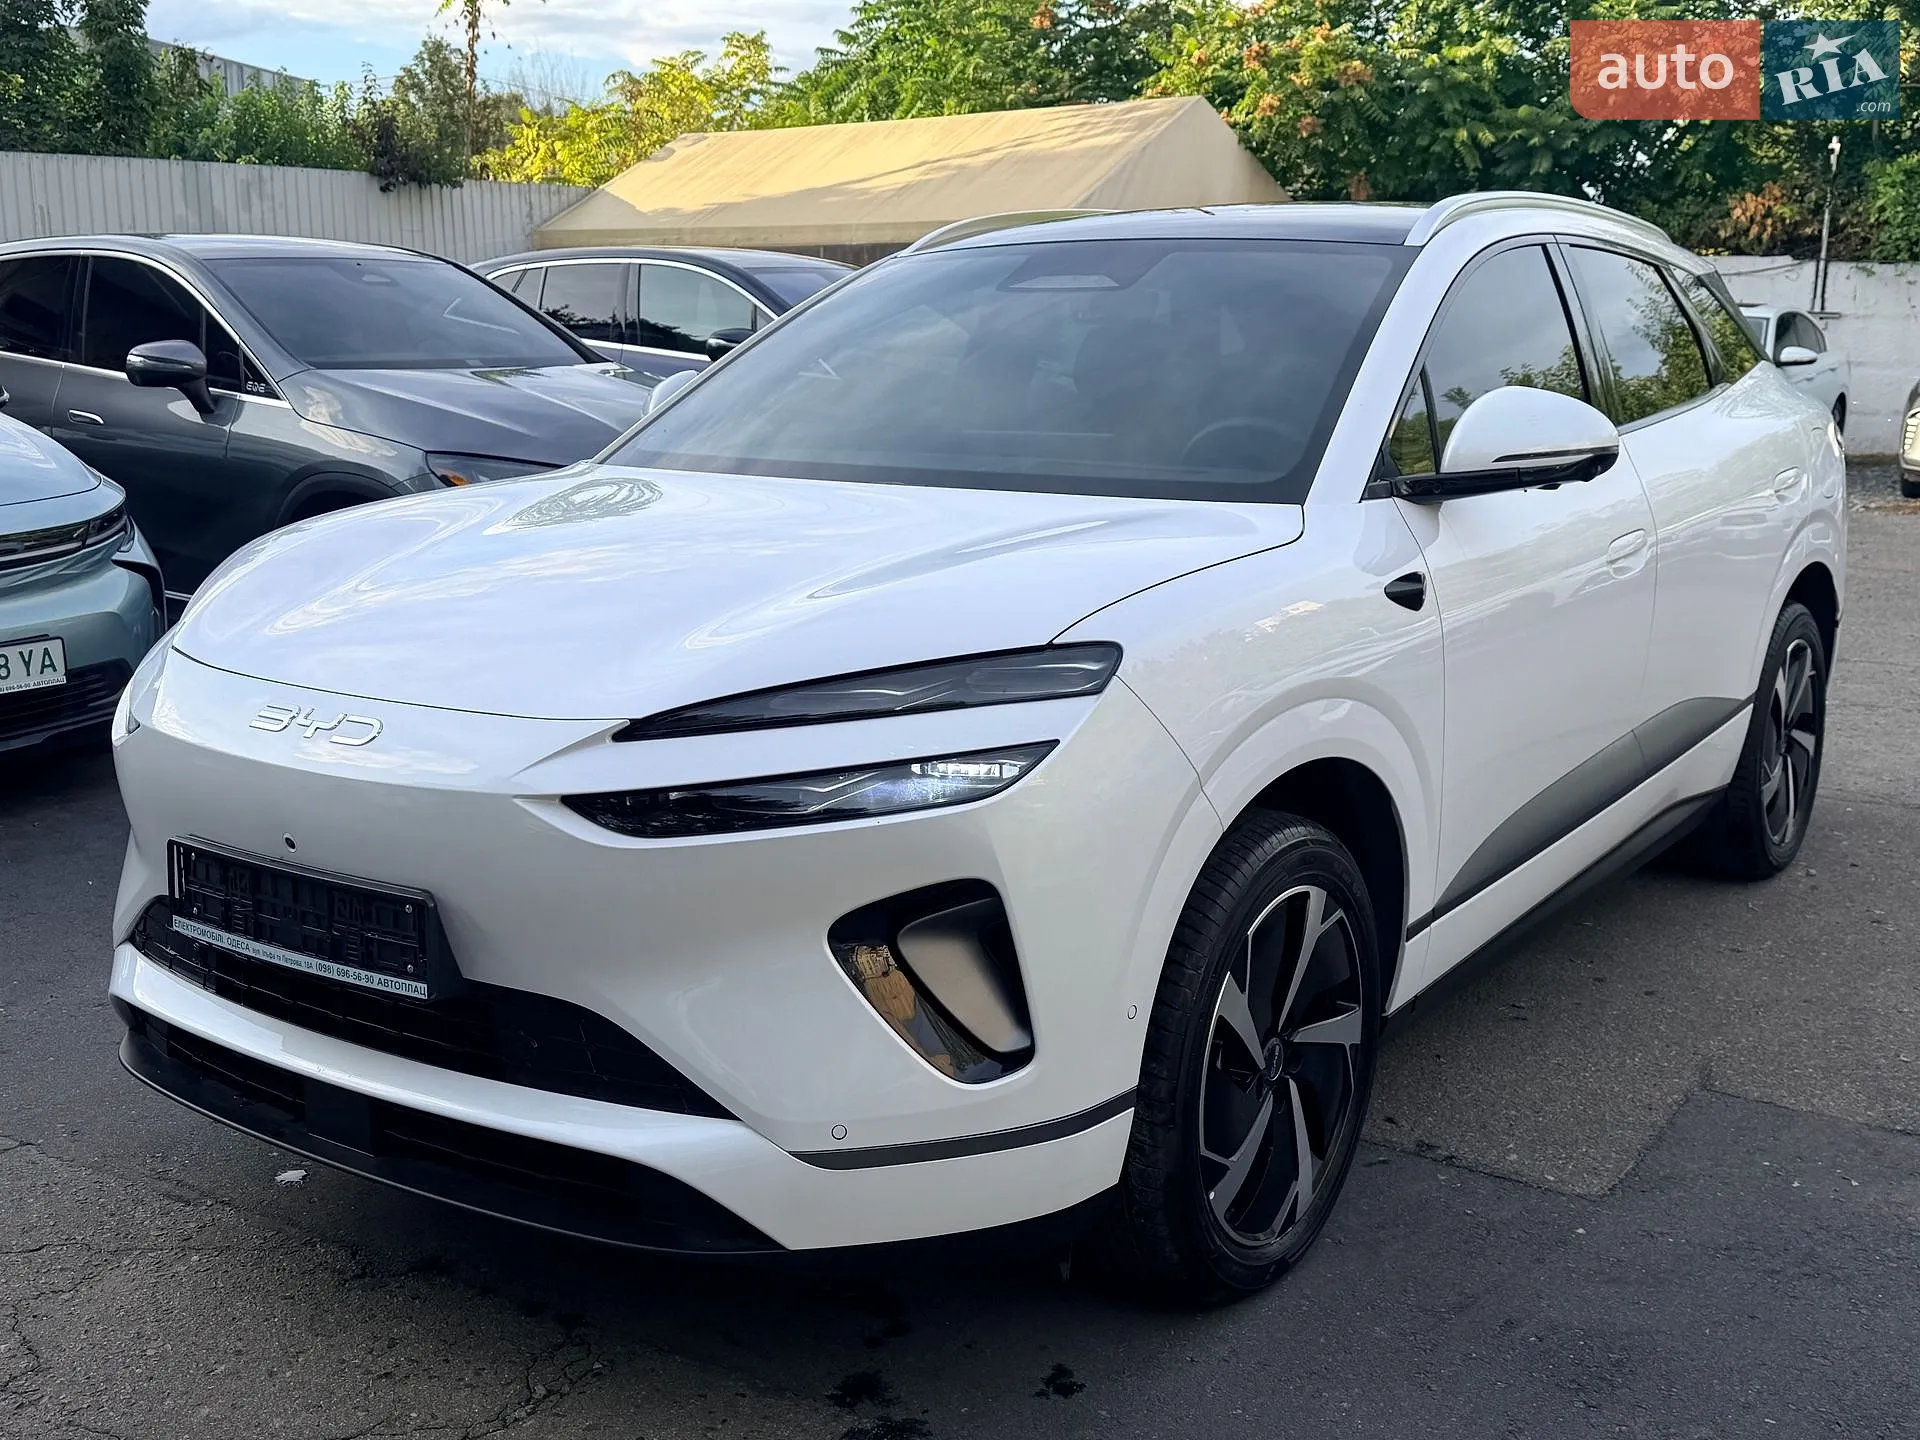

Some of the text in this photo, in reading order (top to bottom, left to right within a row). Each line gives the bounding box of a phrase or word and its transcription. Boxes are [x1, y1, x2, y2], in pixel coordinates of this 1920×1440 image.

[18, 647, 58, 677] YA
[249, 704, 384, 747] BYD
[336, 967, 375, 985] 696-56-90
[377, 977, 427, 997] АВТОПЛАЦ
